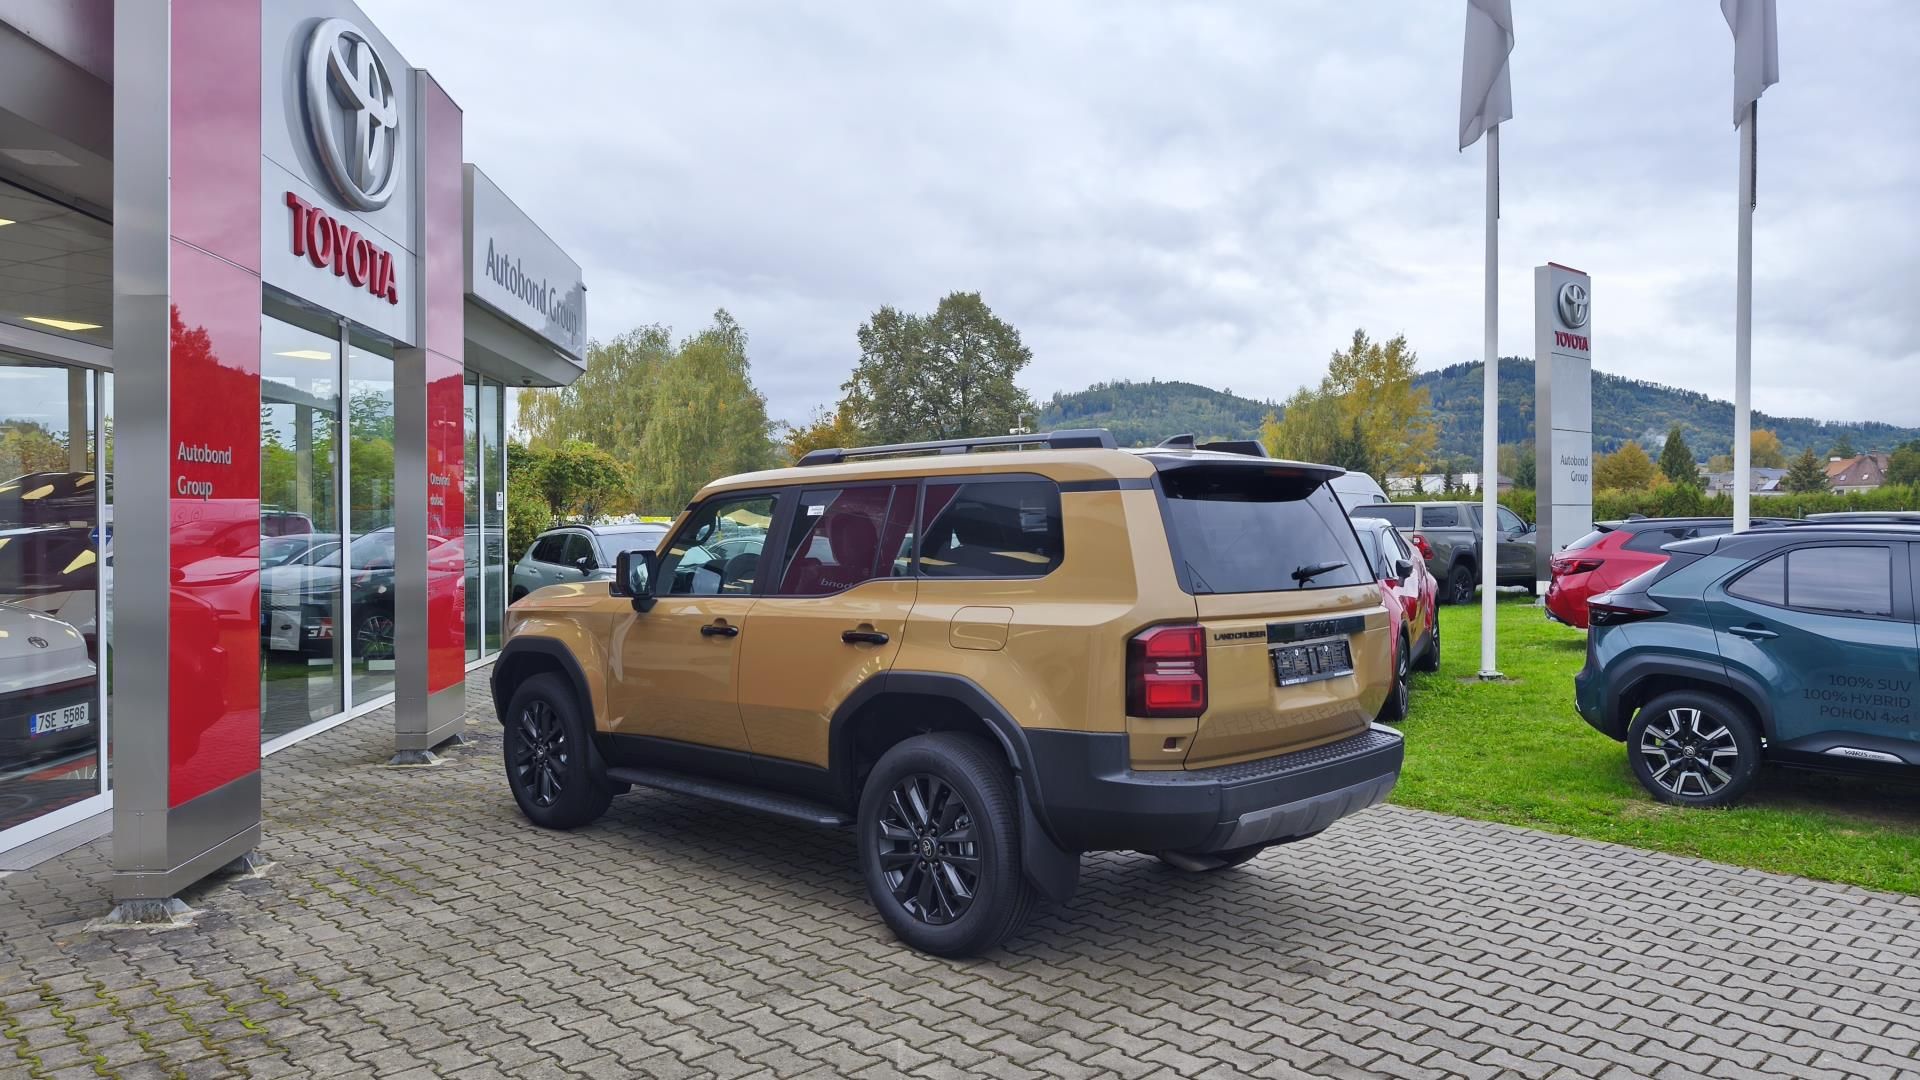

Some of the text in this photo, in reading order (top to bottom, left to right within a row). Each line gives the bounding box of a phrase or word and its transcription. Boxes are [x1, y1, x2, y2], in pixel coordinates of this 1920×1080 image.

[286, 191, 398, 305] TOYOTA
[486, 237, 577, 345] Autobond Group
[1555, 330, 1589, 351] TOYOTA
[178, 441, 232, 465] Autobond
[1560, 455, 1589, 467] Autobond
[177, 475, 213, 501] Group
[1570, 470, 1589, 486] Group
[1829, 674, 1912, 693] 100% SUV
[1803, 687, 1911, 709] 100% HYBRID
[38, 712, 57, 731] 7SE
[63, 705, 85, 724] 5586
[1820, 704, 1910, 725] POHON 4x4
